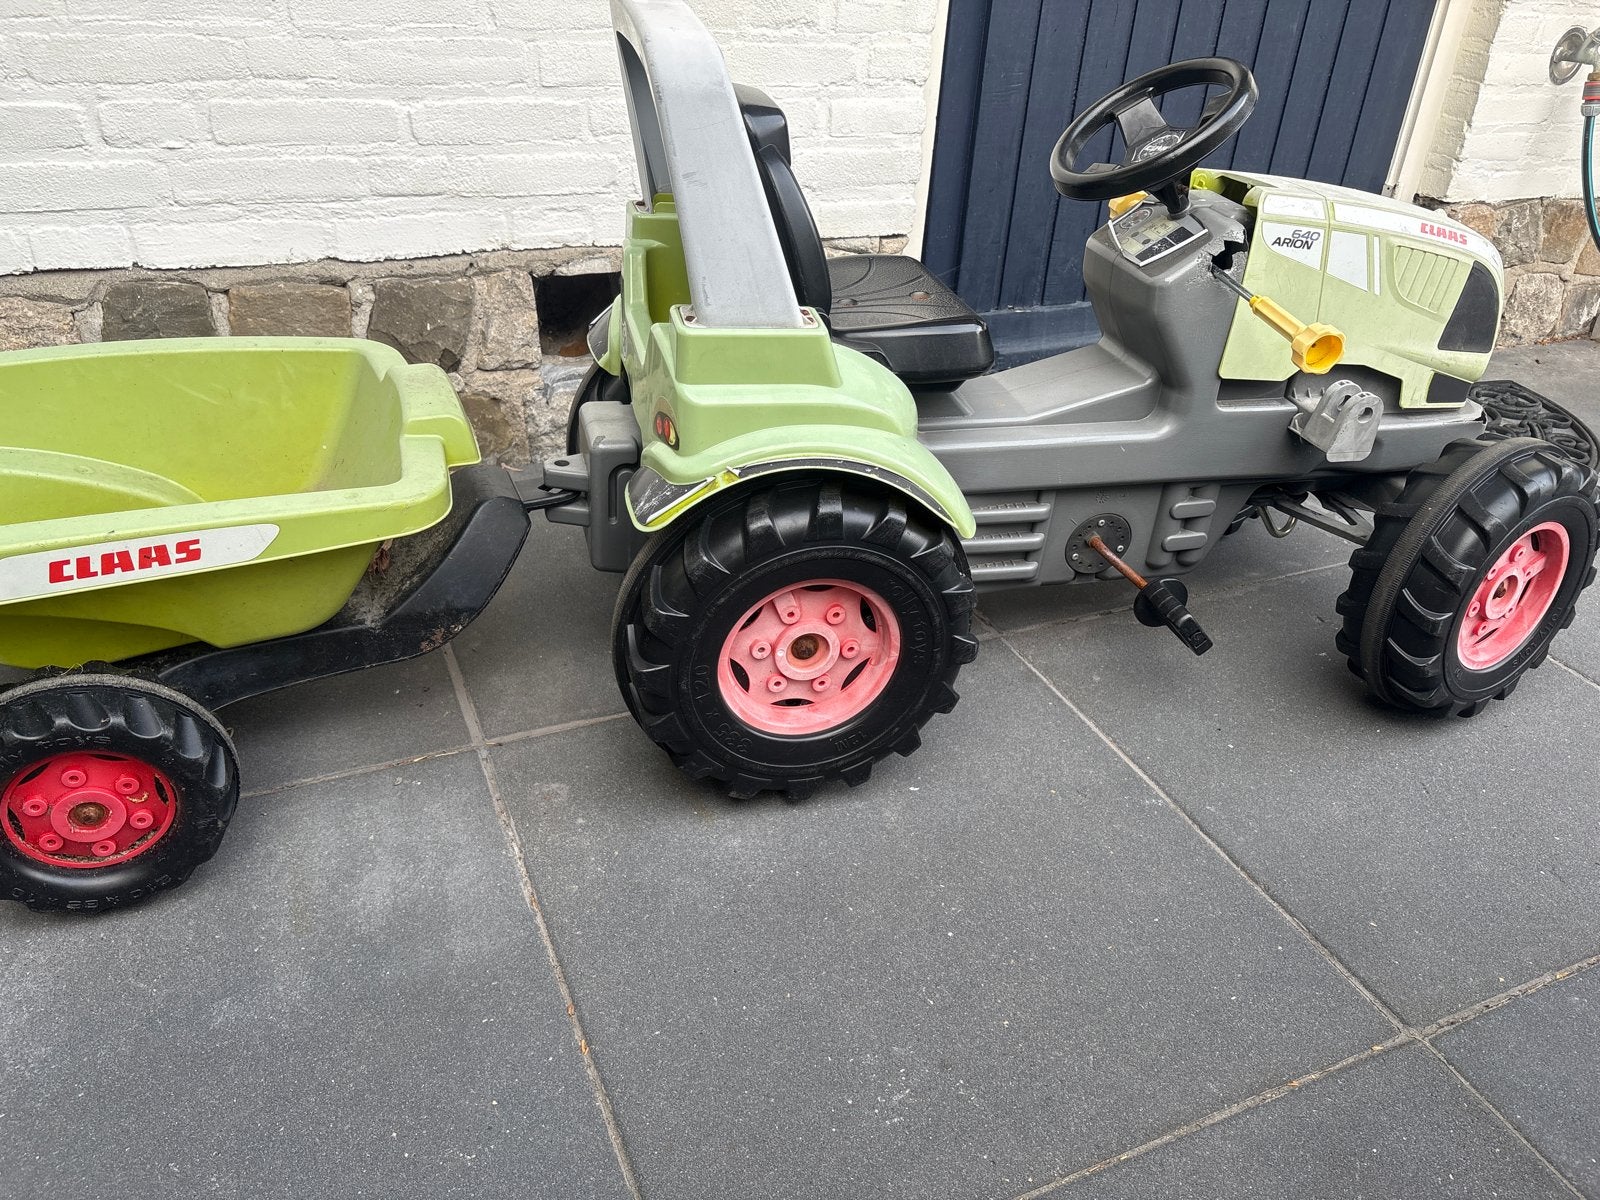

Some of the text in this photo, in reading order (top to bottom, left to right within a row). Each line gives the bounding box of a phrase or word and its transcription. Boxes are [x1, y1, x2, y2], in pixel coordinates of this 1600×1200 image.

[1271, 236, 1313, 250] ARION
[1291, 229, 1321, 242] 640
[1420, 223, 1468, 246] CLAAS
[49, 538, 201, 584] CLAAS
